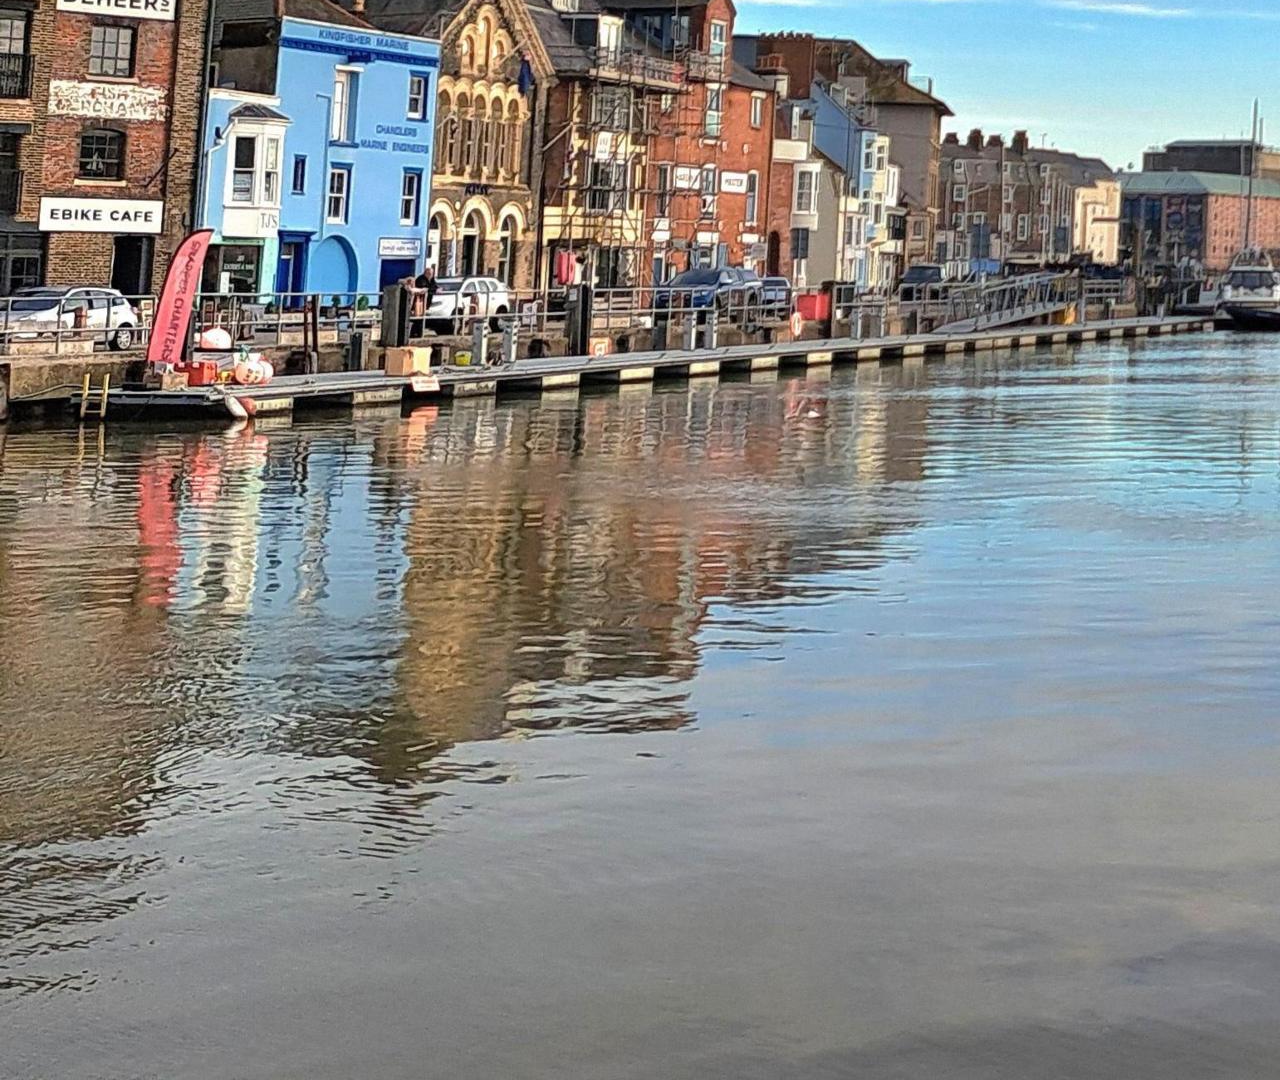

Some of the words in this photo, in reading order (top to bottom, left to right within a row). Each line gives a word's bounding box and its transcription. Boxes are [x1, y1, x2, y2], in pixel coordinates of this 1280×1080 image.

[319, 29, 372, 46] KINGFISHER
[375, 37, 410, 51] MARINE
[50, 208, 102, 221] EBIKE
[110, 210, 153, 222] CAFE
[161, 298, 185, 363] CHARTERS
